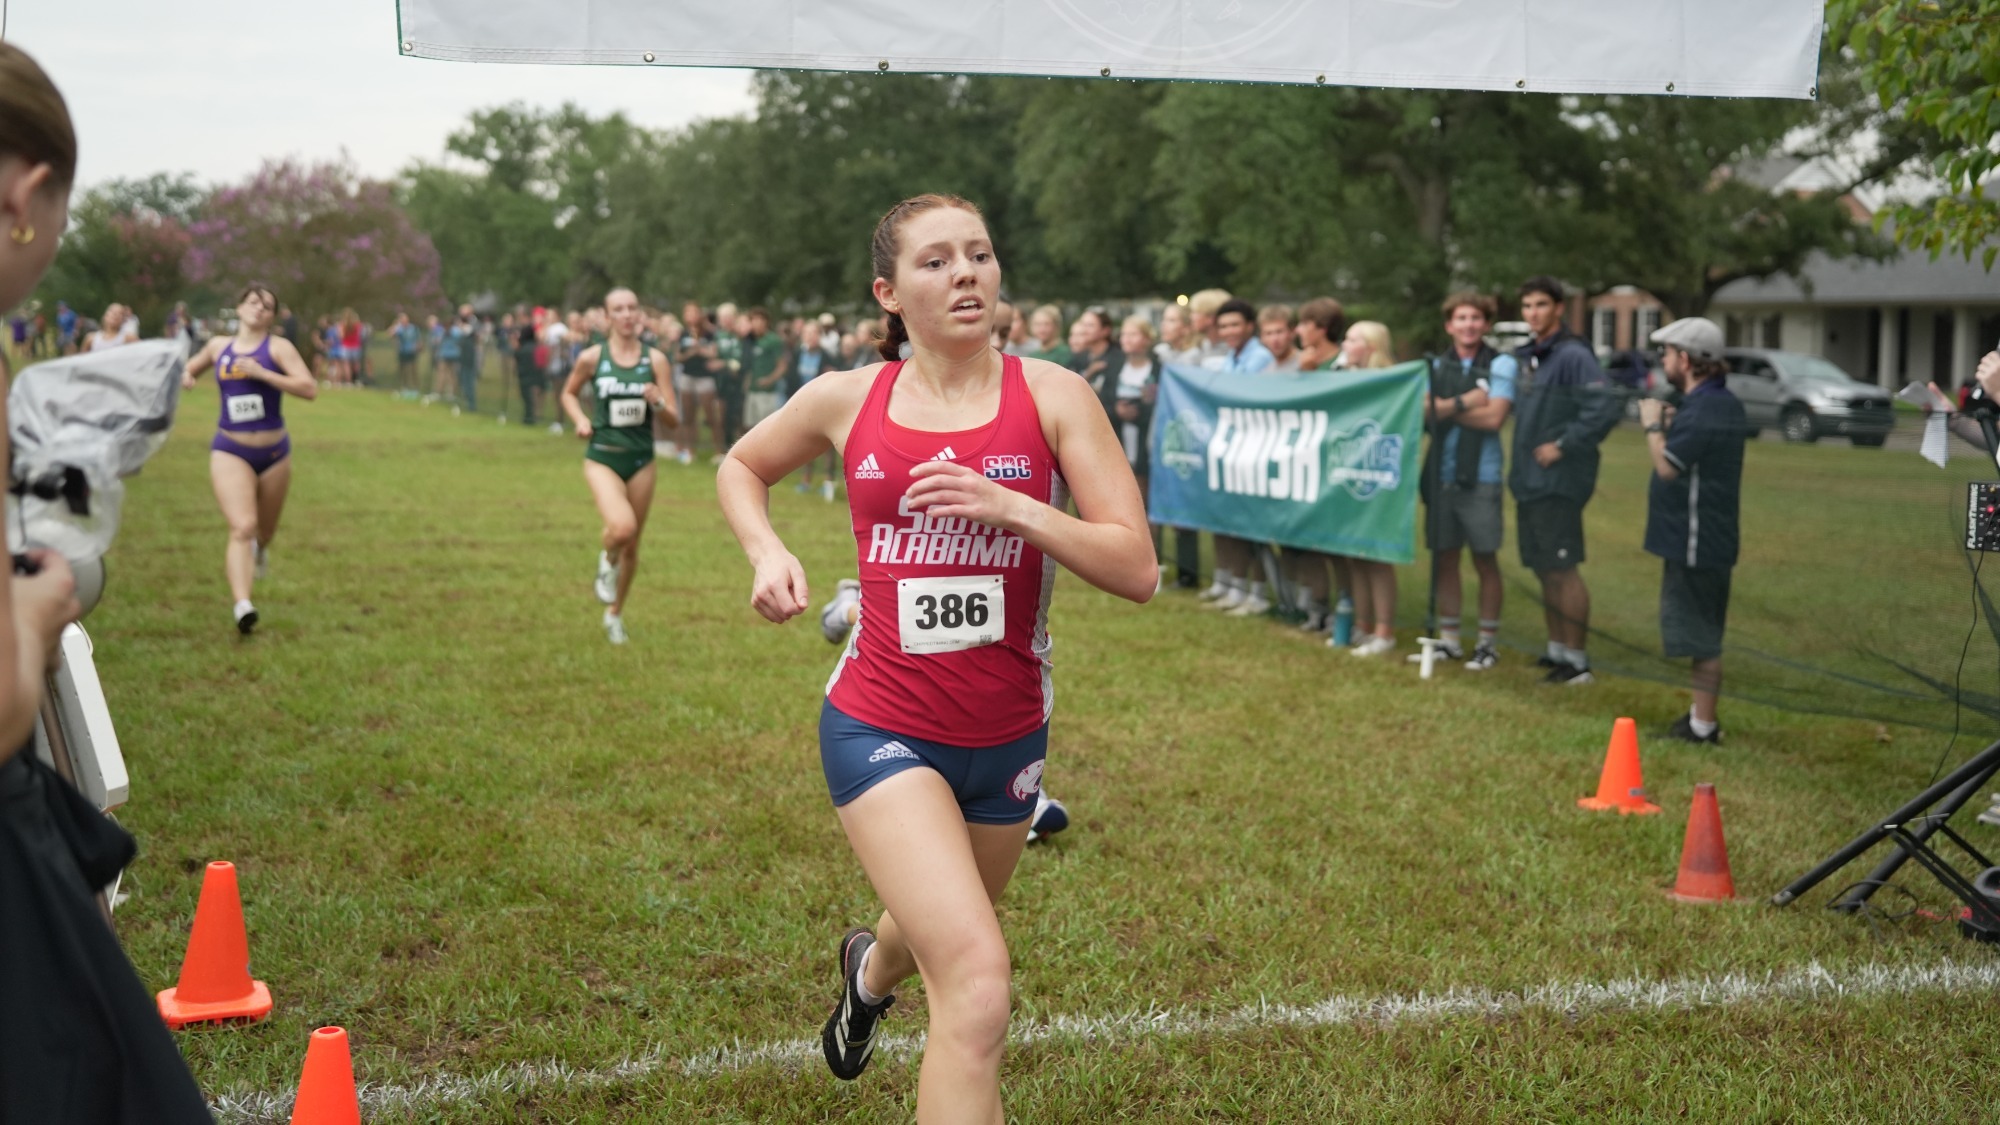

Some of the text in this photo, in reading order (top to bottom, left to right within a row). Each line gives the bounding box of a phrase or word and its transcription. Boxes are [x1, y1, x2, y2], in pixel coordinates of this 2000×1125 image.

[983, 455, 1032, 480] SBC
[1207, 407, 1328, 503] FINISH
[855, 469, 885, 480] adidas
[867, 523, 1024, 568] ALABAMA
[915, 592, 989, 630] 386
[868, 750, 920, 763] adidas
